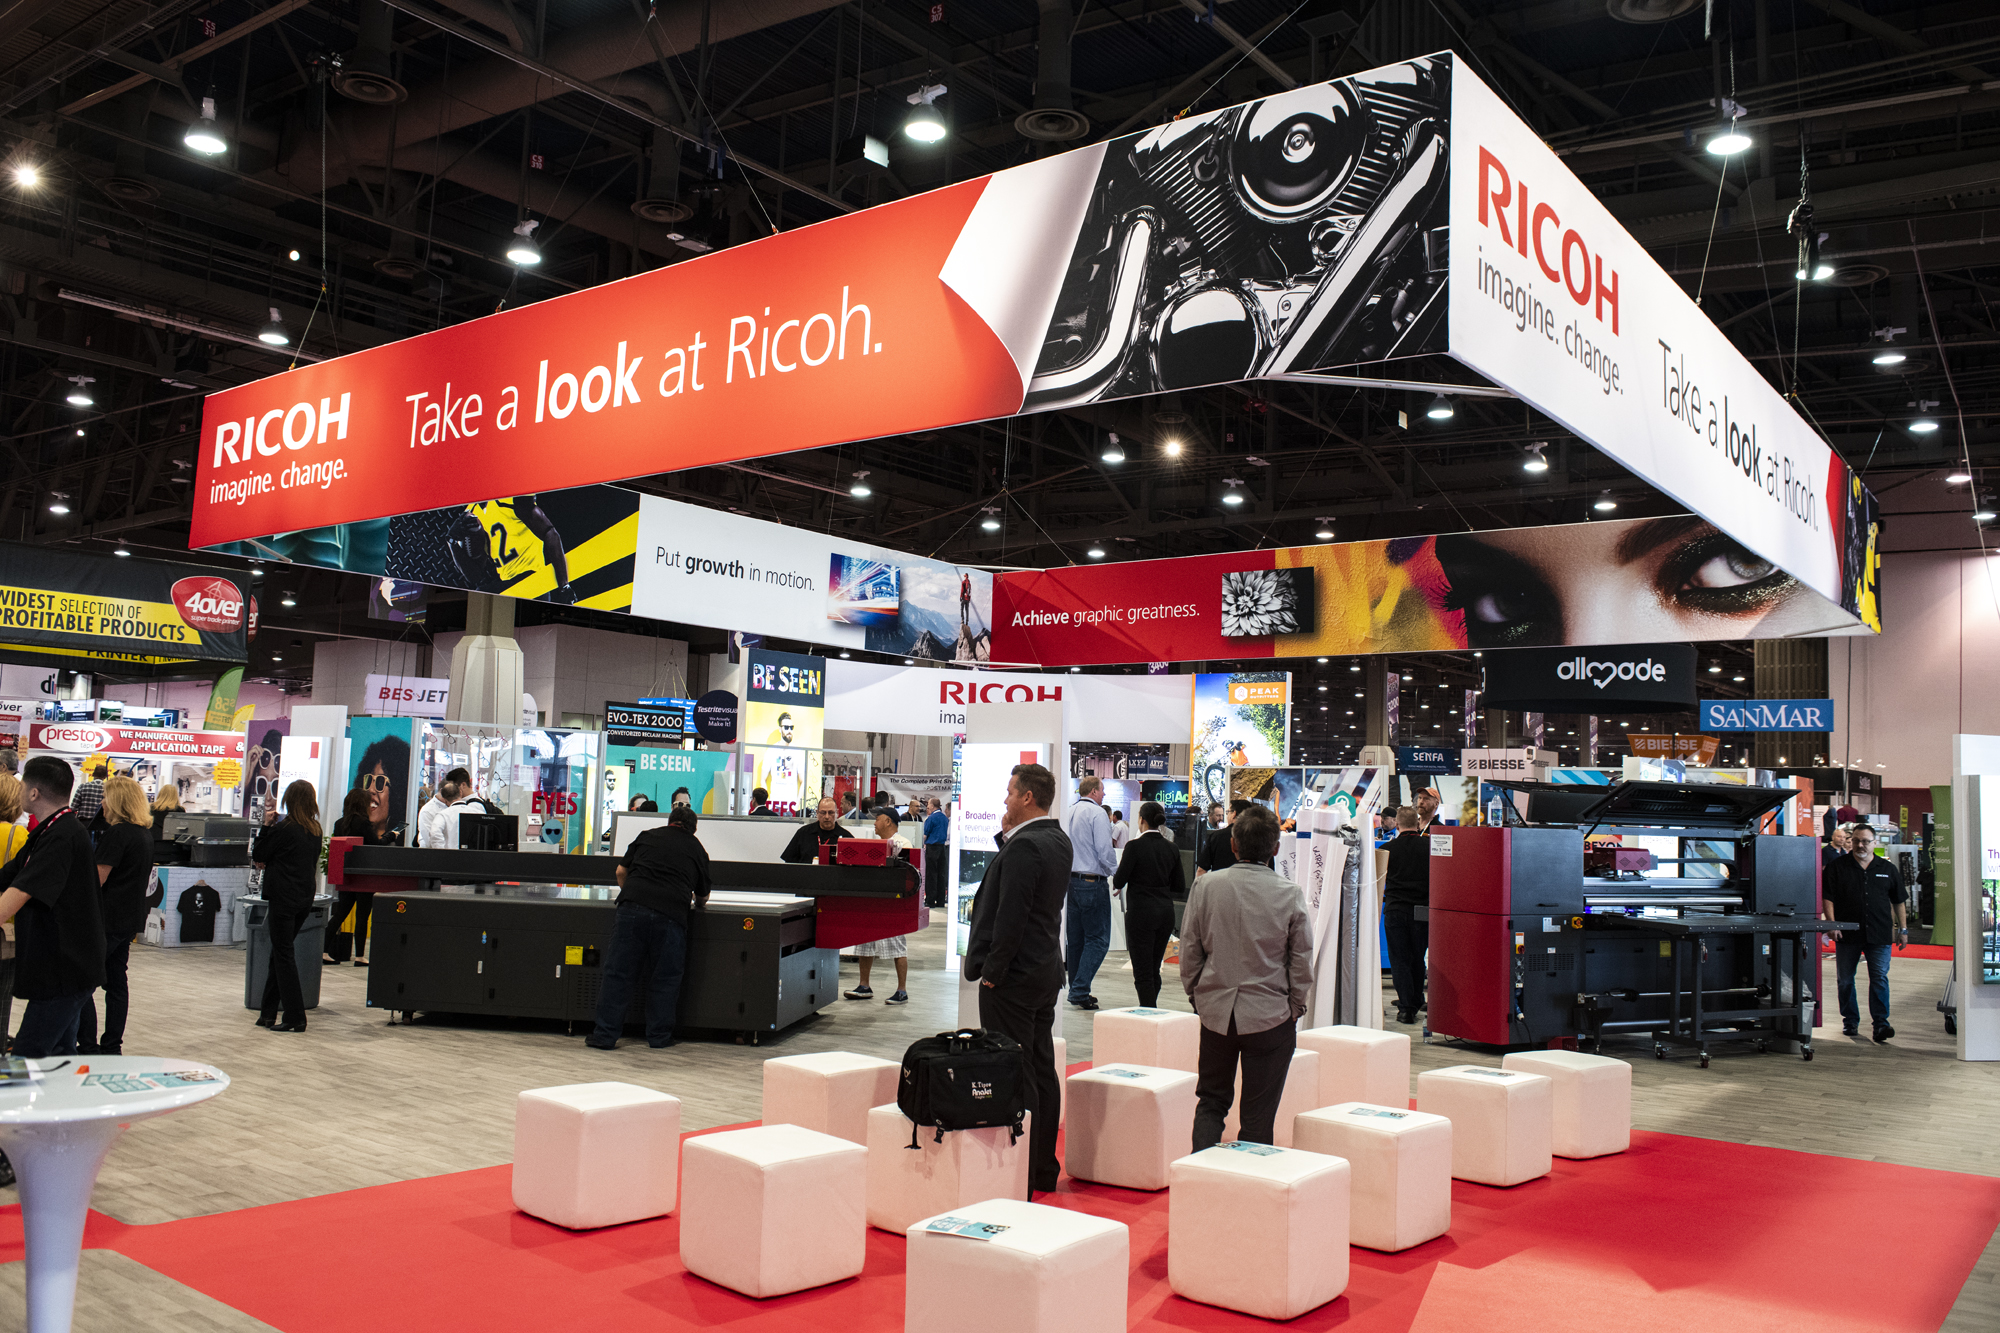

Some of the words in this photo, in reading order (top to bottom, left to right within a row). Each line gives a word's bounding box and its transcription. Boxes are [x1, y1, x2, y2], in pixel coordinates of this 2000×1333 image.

[1478, 143, 1619, 338] RICOH
[1478, 244, 1559, 345] imagine.
[1564, 318, 1624, 396] change.
[404, 382, 485, 450] Take
[495, 384, 520, 432] a
[533, 340, 644, 424] look
[658, 330, 707, 398] at
[724, 285, 883, 384] Ricoh.
[212, 391, 351, 469] RICOH
[1658, 337, 1702, 436] Take
[1708, 399, 1718, 449] a
[1723, 394, 1763, 488] look
[1767, 450, 1780, 503] at
[1783, 455, 1819, 532] Ricoh.
[209, 466, 277, 505] imagine.
[280, 456, 348, 491] change.
[656, 545, 682, 569] Put
[685, 555, 745, 583] growth
[749, 562, 761, 582] in
[765, 566, 816, 591] motion.
[60, 599, 123, 618] SELECTION
[128, 605, 142, 619] OF
[185, 592, 243, 618] 4over
[1012, 608, 1070, 628] Achieve
[1073, 605, 1124, 629] graphic
[1128, 600, 1202, 625] greatness.
[100, 618, 185, 641] PRODUCTS
[753, 663, 775, 690] BE
[778, 666, 821, 695] SEEN
[940, 680, 1062, 706] RICOH
[607, 712, 649, 725] EVO-TEX
[651, 715, 682, 727] 2000
[46, 728, 96, 744] presto
[120, 730, 133, 739] WE
[134, 732, 194, 742] MANUFACTURE
[130, 741, 198, 753] APPLICATION
[201, 745, 226, 754] TAPE
[1647, 739, 1699, 750] BIESSE
[640, 753, 657, 770] BE
[659, 754, 696, 773] SEEN.
[1413, 752, 1444, 761] SENFA
[1480, 759, 1526, 771] BIESSE
[532, 791, 578, 815] EYES
[965, 810, 996, 820] Broaden
